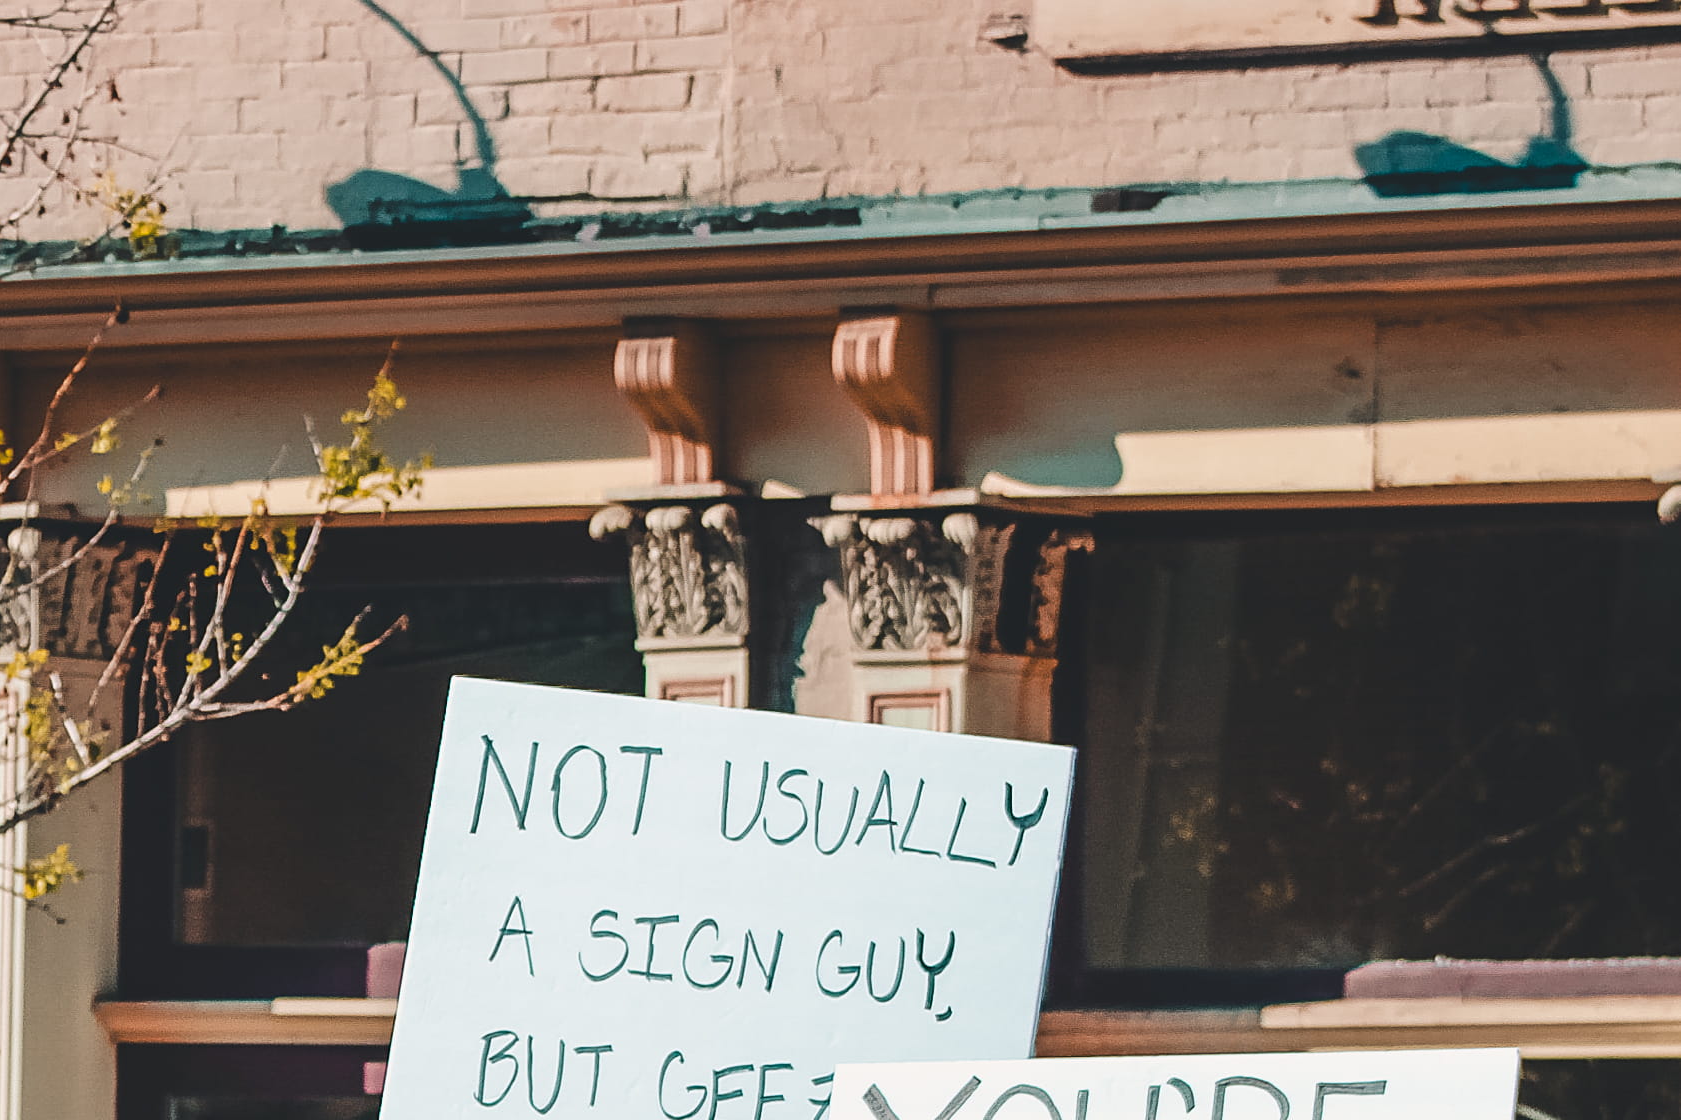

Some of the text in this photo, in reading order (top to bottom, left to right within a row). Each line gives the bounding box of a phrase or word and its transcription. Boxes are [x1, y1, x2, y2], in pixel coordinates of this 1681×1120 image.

[470, 734, 1050, 868] NOT USUALLY
[488, 895, 956, 1022] A SIGN GUY,
[473, 1030, 614, 1115] BUT
